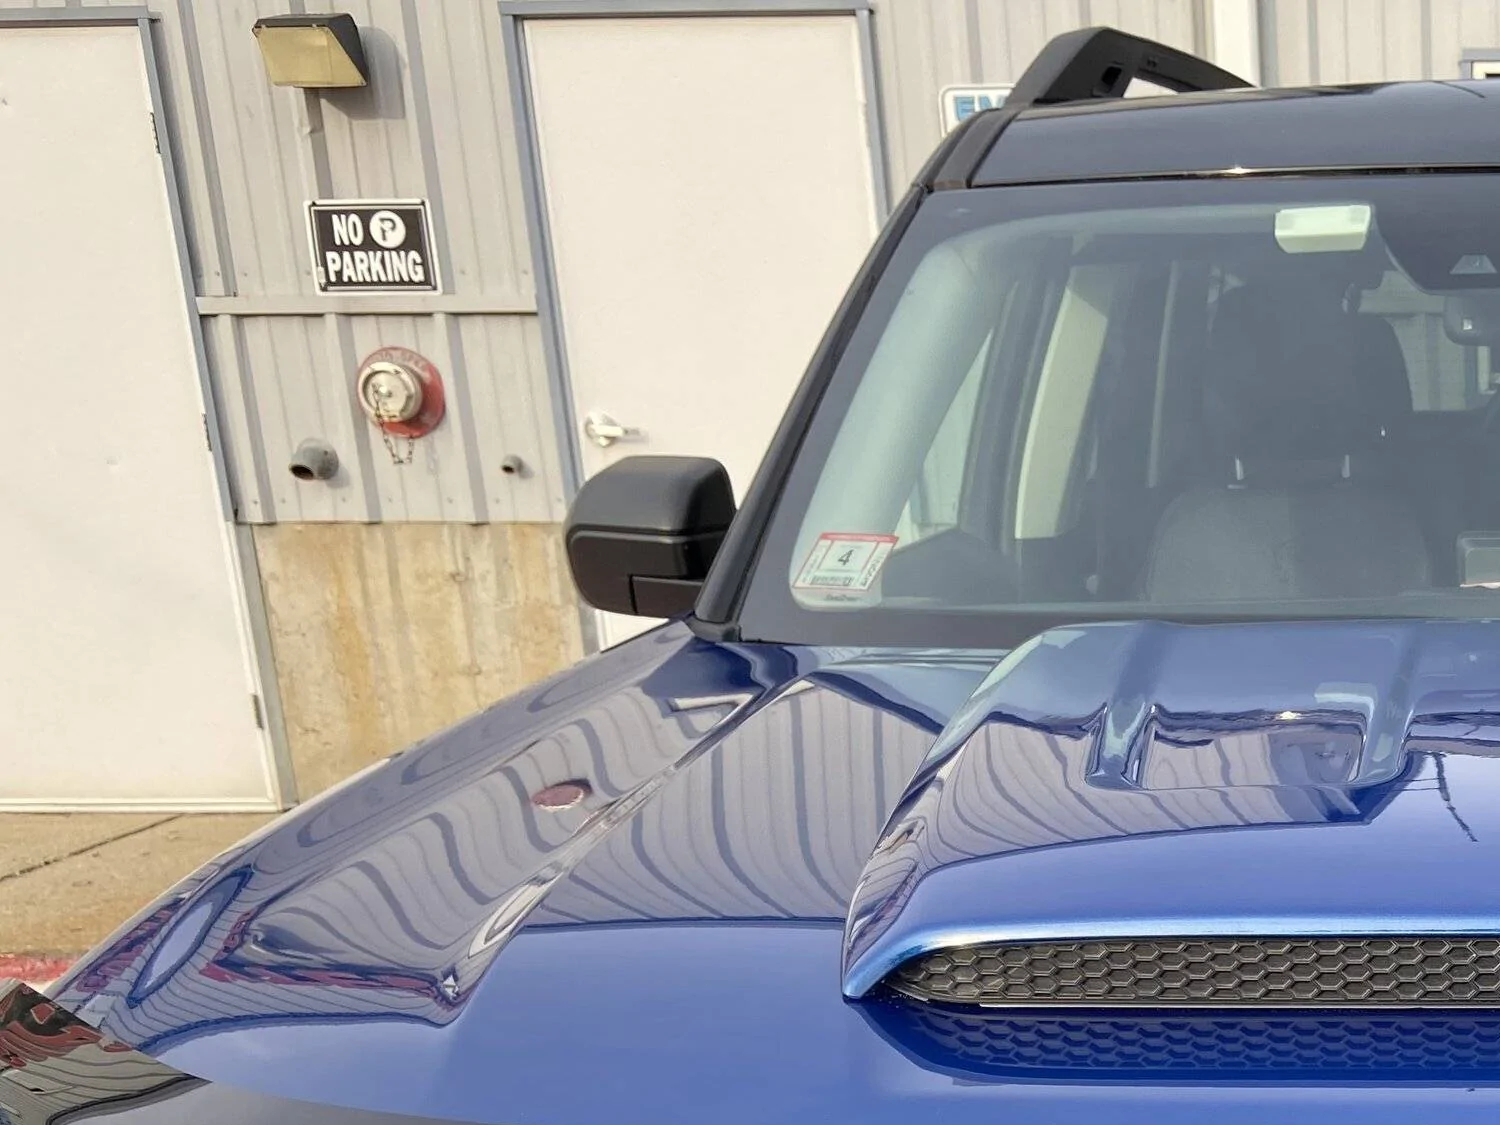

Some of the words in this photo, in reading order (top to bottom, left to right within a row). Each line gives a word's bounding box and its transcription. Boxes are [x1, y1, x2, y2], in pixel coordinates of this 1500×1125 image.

[331, 213, 364, 246] NO
[325, 250, 425, 283] PARKING
[838, 549, 854, 566] 4
